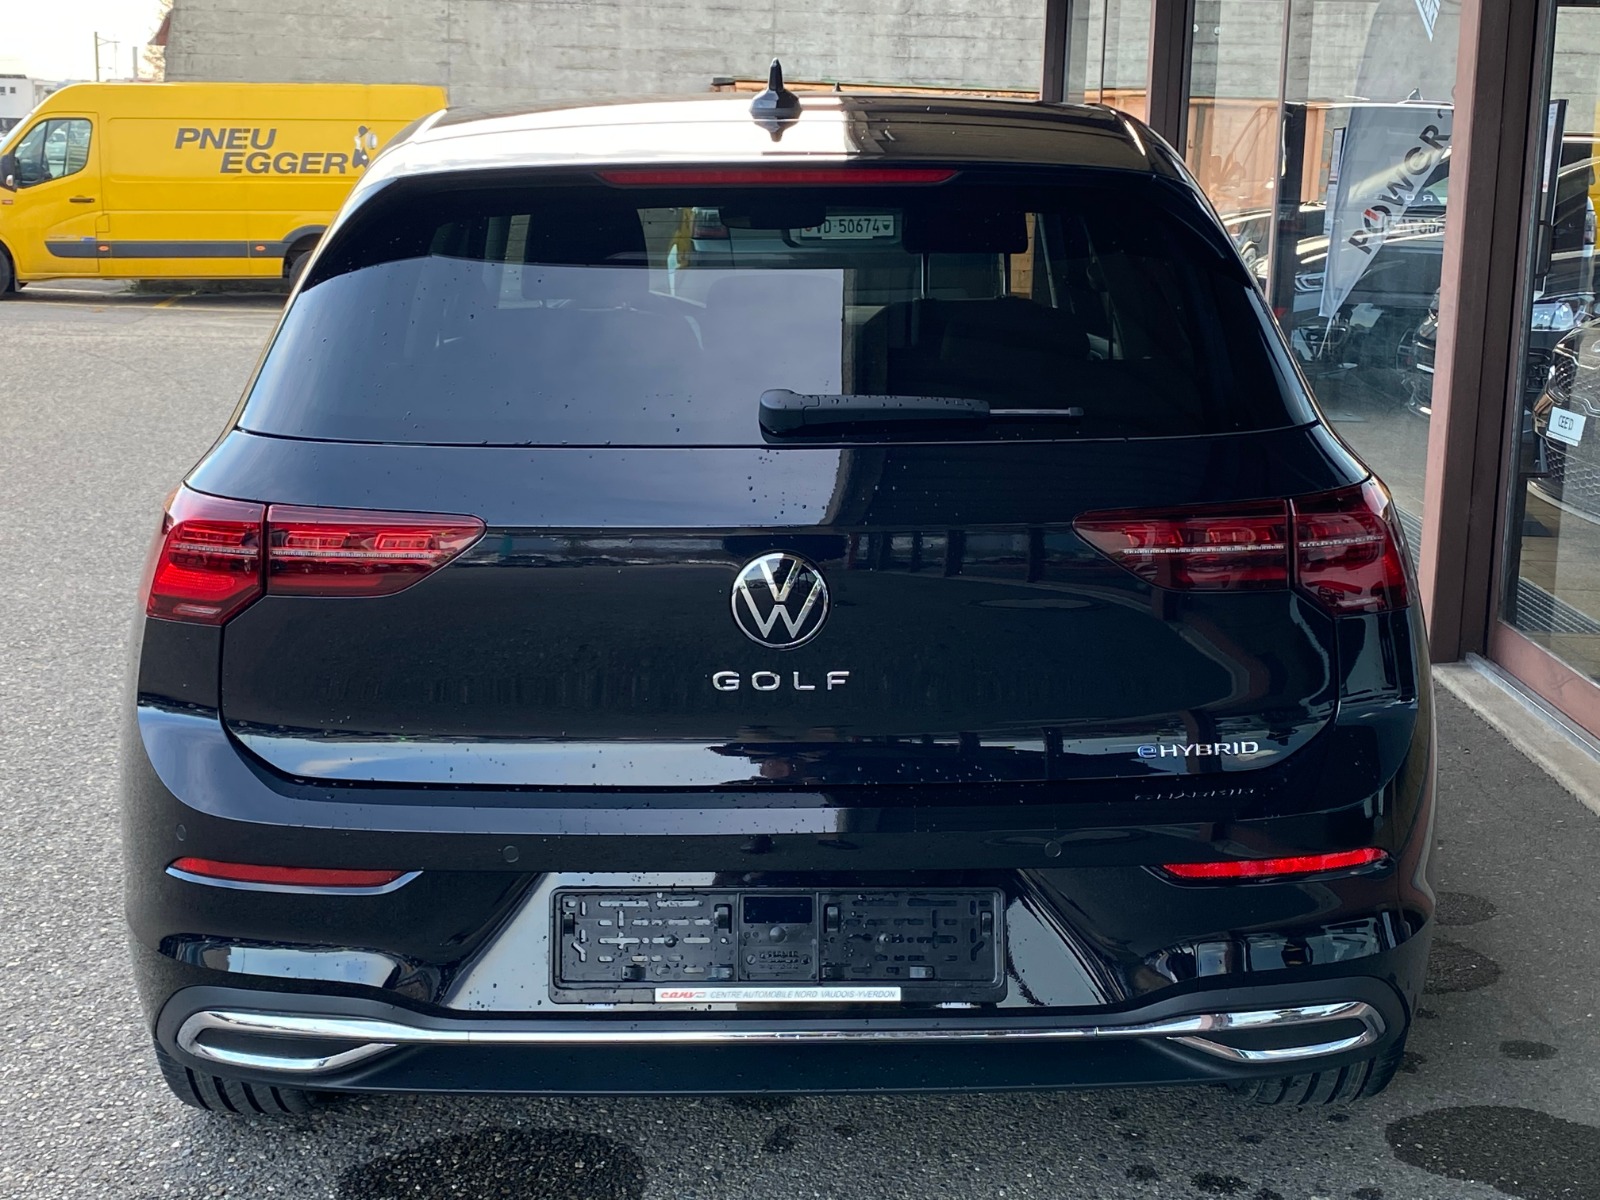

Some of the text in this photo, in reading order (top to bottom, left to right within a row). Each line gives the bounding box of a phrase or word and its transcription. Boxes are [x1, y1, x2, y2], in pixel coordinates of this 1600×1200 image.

[174, 128, 277, 150] PNEU
[219, 152, 349, 174] EGGER
[712, 670, 850, 691] GOLF
[1137, 741, 1259, 758] eHYBRID
[710, 990, 742, 999] CENTRE
[743, 990, 793, 999] AUTOMOBILE
[794, 990, 818, 999] NORD
